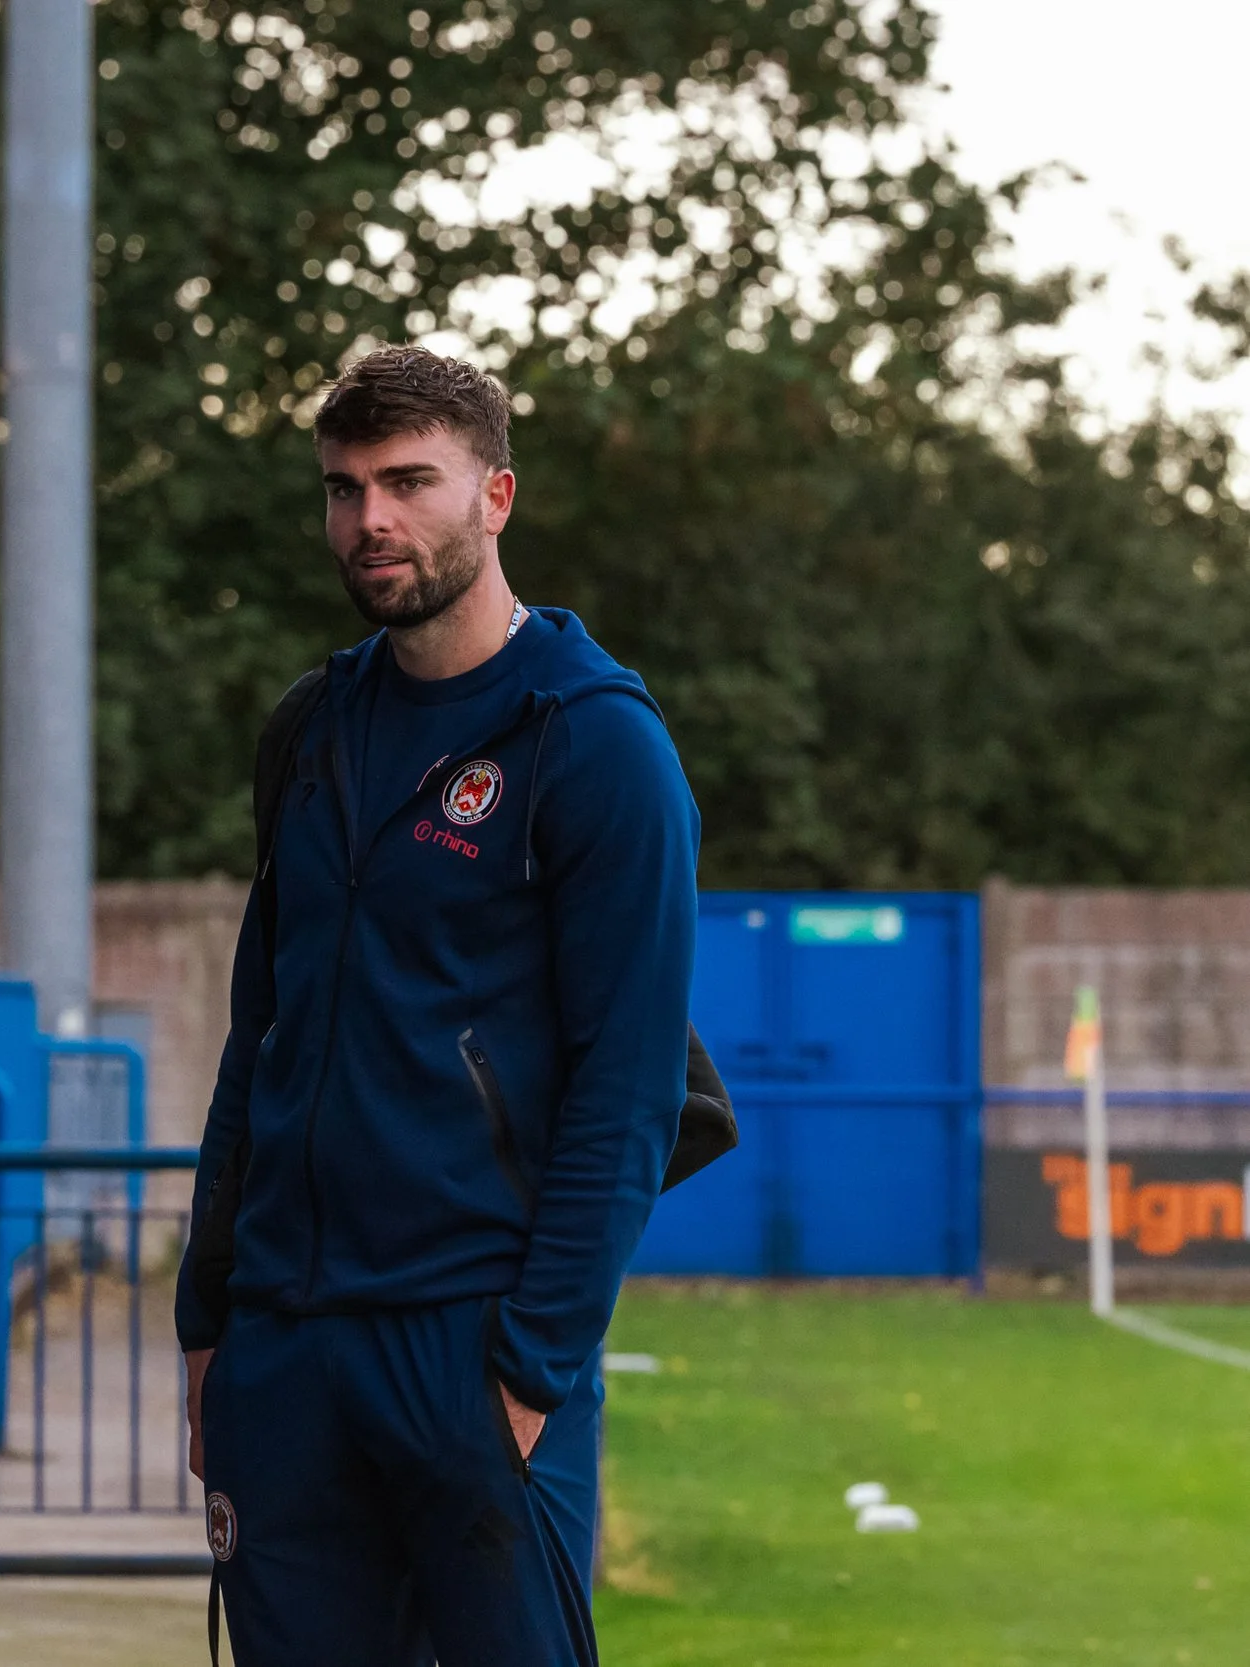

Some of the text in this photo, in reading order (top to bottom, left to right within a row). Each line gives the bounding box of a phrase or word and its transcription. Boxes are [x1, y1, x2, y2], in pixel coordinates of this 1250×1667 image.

[483, 763, 499, 781] UNITED
[445, 802, 482, 822] FOOTBALL CLUB
[433, 829, 480, 859] rhino
